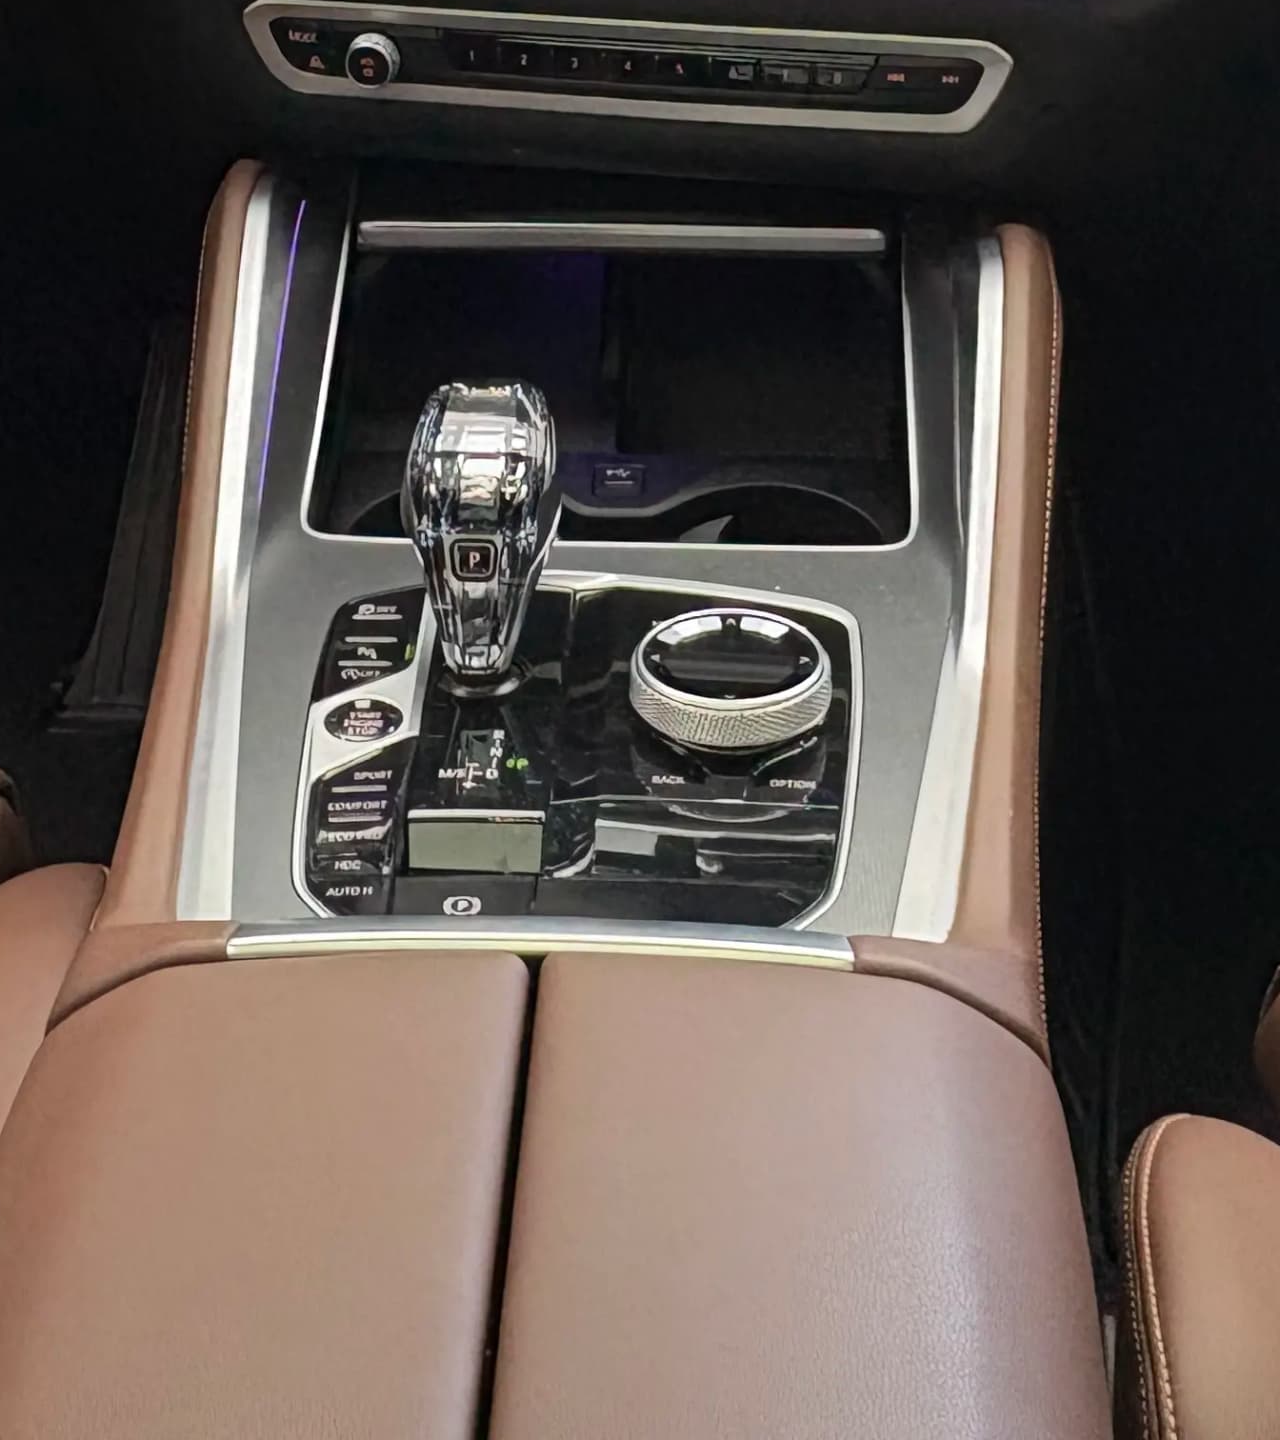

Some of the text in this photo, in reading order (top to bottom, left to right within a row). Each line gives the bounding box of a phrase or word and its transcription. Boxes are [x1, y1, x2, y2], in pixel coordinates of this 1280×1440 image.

[469, 551, 480, 569] P
[651, 775, 686, 785] BACK
[769, 779, 817, 790] OPTION
[325, 886, 360, 897] AUTO
